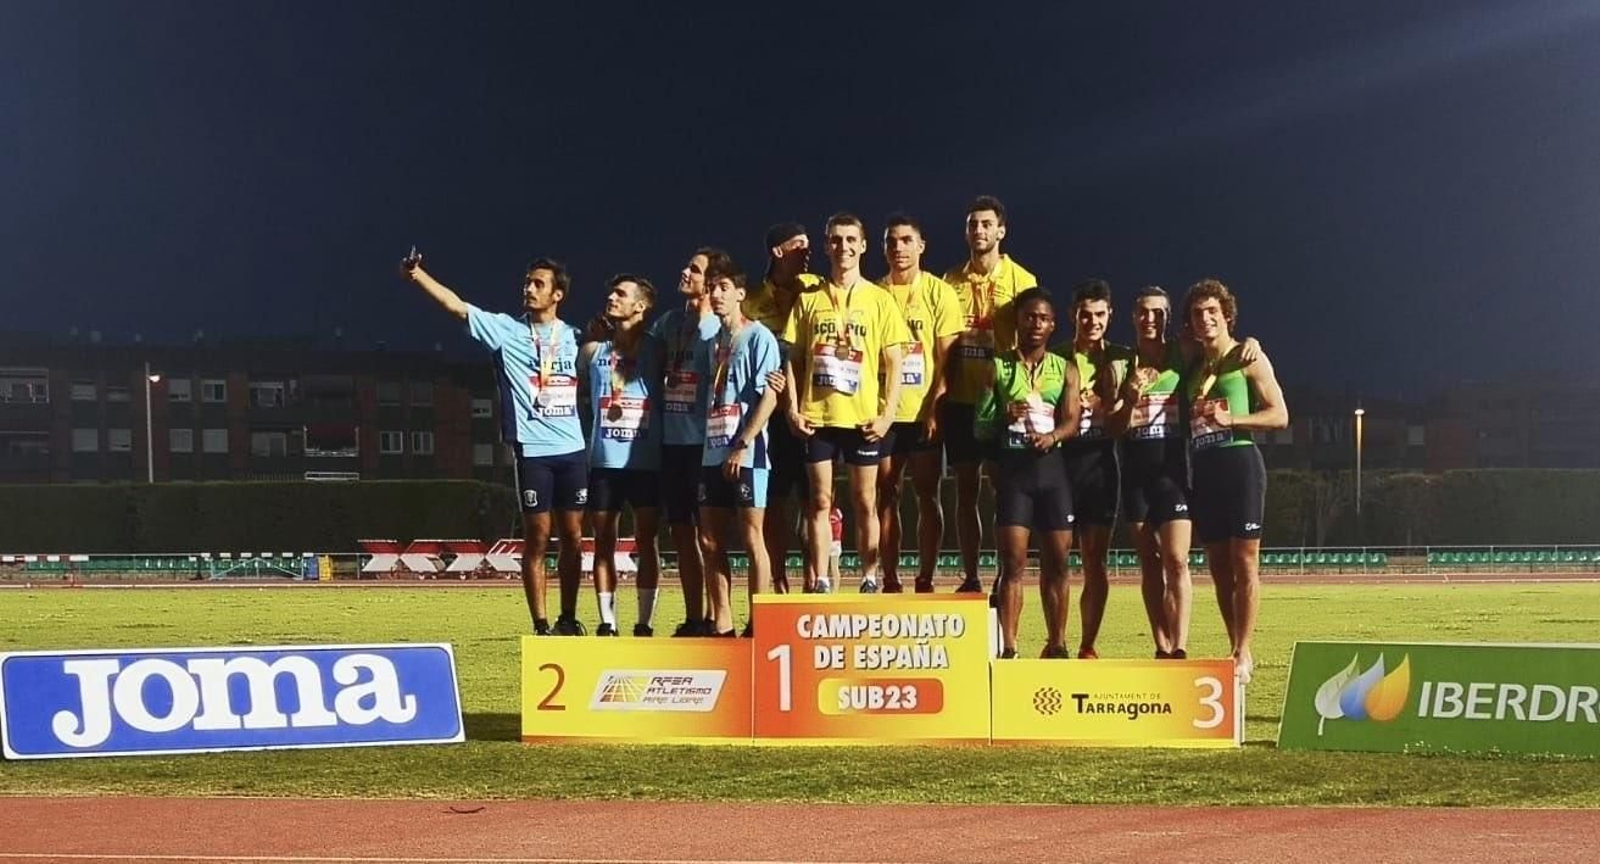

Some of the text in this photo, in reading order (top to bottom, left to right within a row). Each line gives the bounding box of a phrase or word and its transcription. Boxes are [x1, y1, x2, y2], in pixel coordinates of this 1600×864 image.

[815, 321, 867, 337] SCOPIO
[797, 614, 965, 638] CAMPEONATO
[814, 640, 949, 669] DE ESPAÑA
[537, 663, 566, 711] 2
[651, 676, 694, 685] RFEA
[767, 644, 791, 711] 1
[647, 687, 712, 695] ATLETISMO
[838, 685, 918, 709] SUB23
[1192, 675, 1226, 729] 3
[1418, 681, 1600, 723] IBERDR
